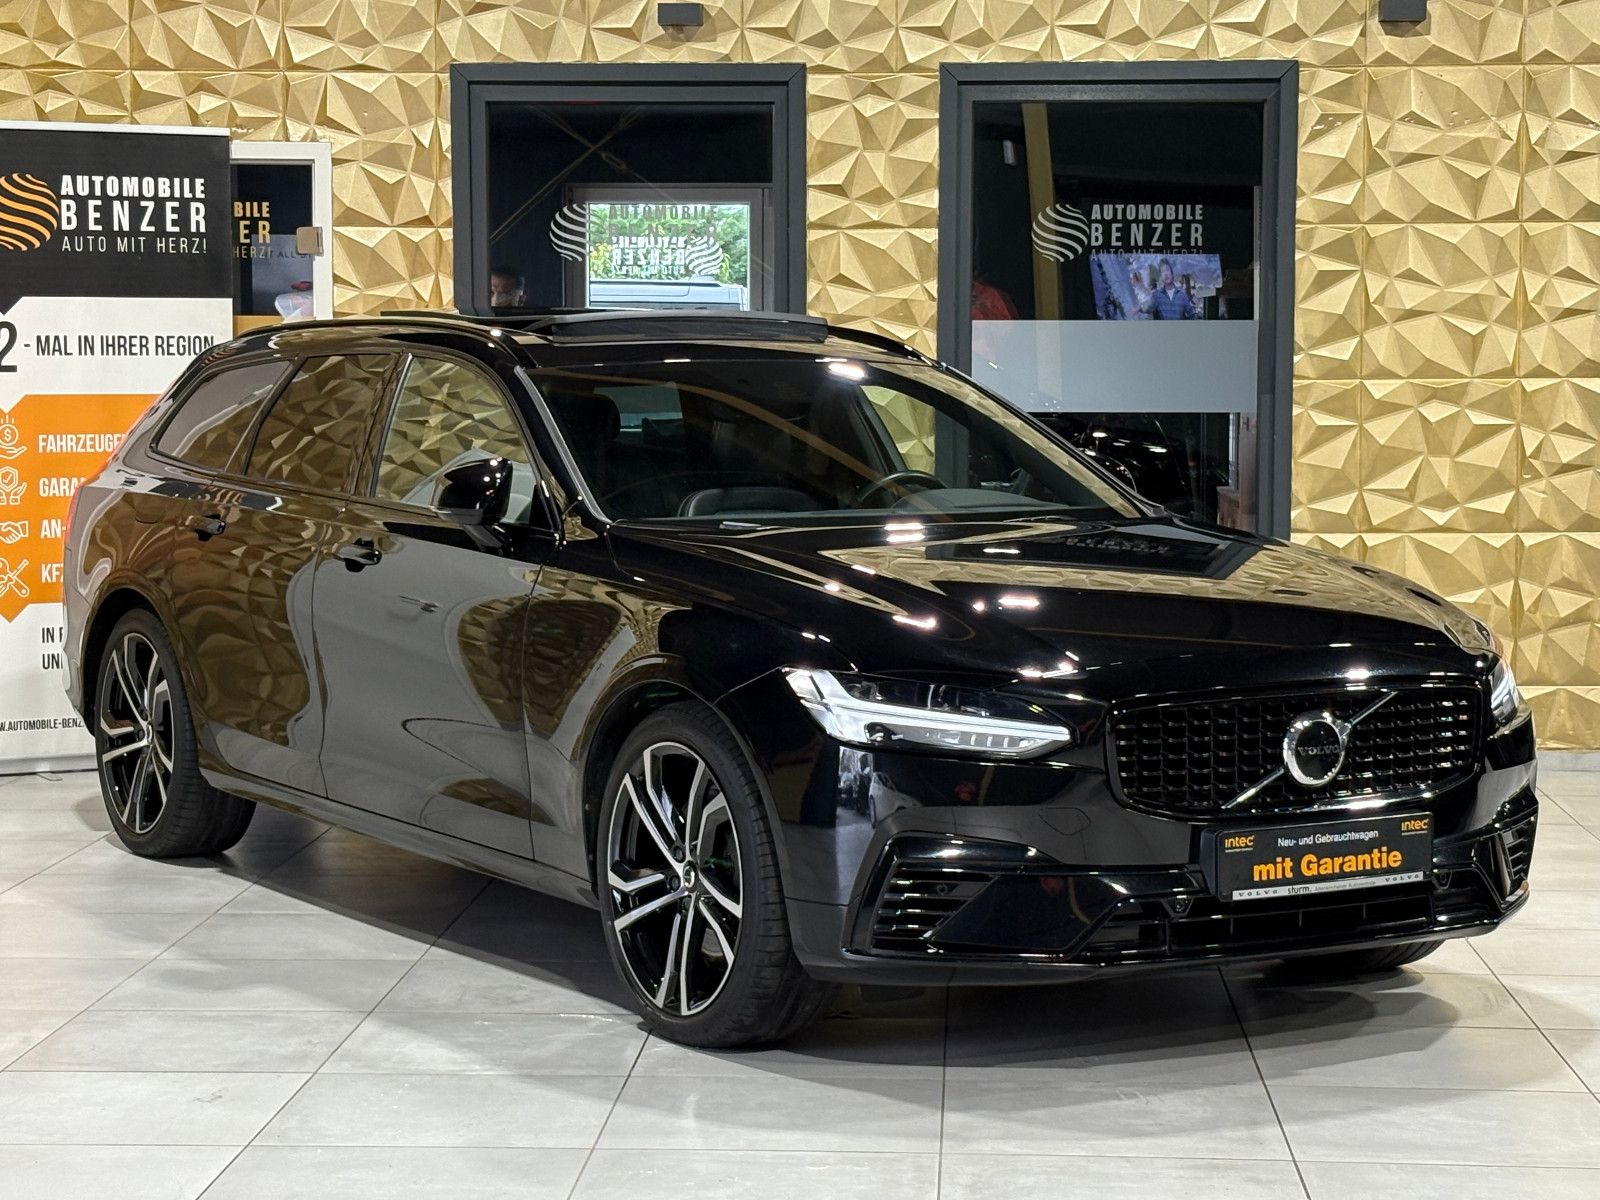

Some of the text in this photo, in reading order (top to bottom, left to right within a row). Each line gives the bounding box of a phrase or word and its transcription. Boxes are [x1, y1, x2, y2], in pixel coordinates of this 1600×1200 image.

[60, 174, 206, 199] AUTOMOBILE
[60, 199, 206, 233] BENZER
[1091, 204, 1204, 220] AUTOMOBILE
[61, 235, 207, 254] AUTO MIT HERZ!
[1090, 223, 1203, 247] BENZER
[36, 335, 73, 356] MAL
[78, 335, 95, 356] IN
[100, 335, 150, 356] IHRER
[155, 335, 214, 356] REGION
[41, 627, 55, 643] IN
[42, 653, 64, 669] UN
[1297, 744, 1340, 756] VOLVO
[1277, 830, 1379, 847] Neu- und Gebrauchtwagen
[1253, 846, 1402, 881] mit Garantie
[1238, 889, 1278, 898] VOLVO
[1384, 873, 1420, 883] VOLVO
